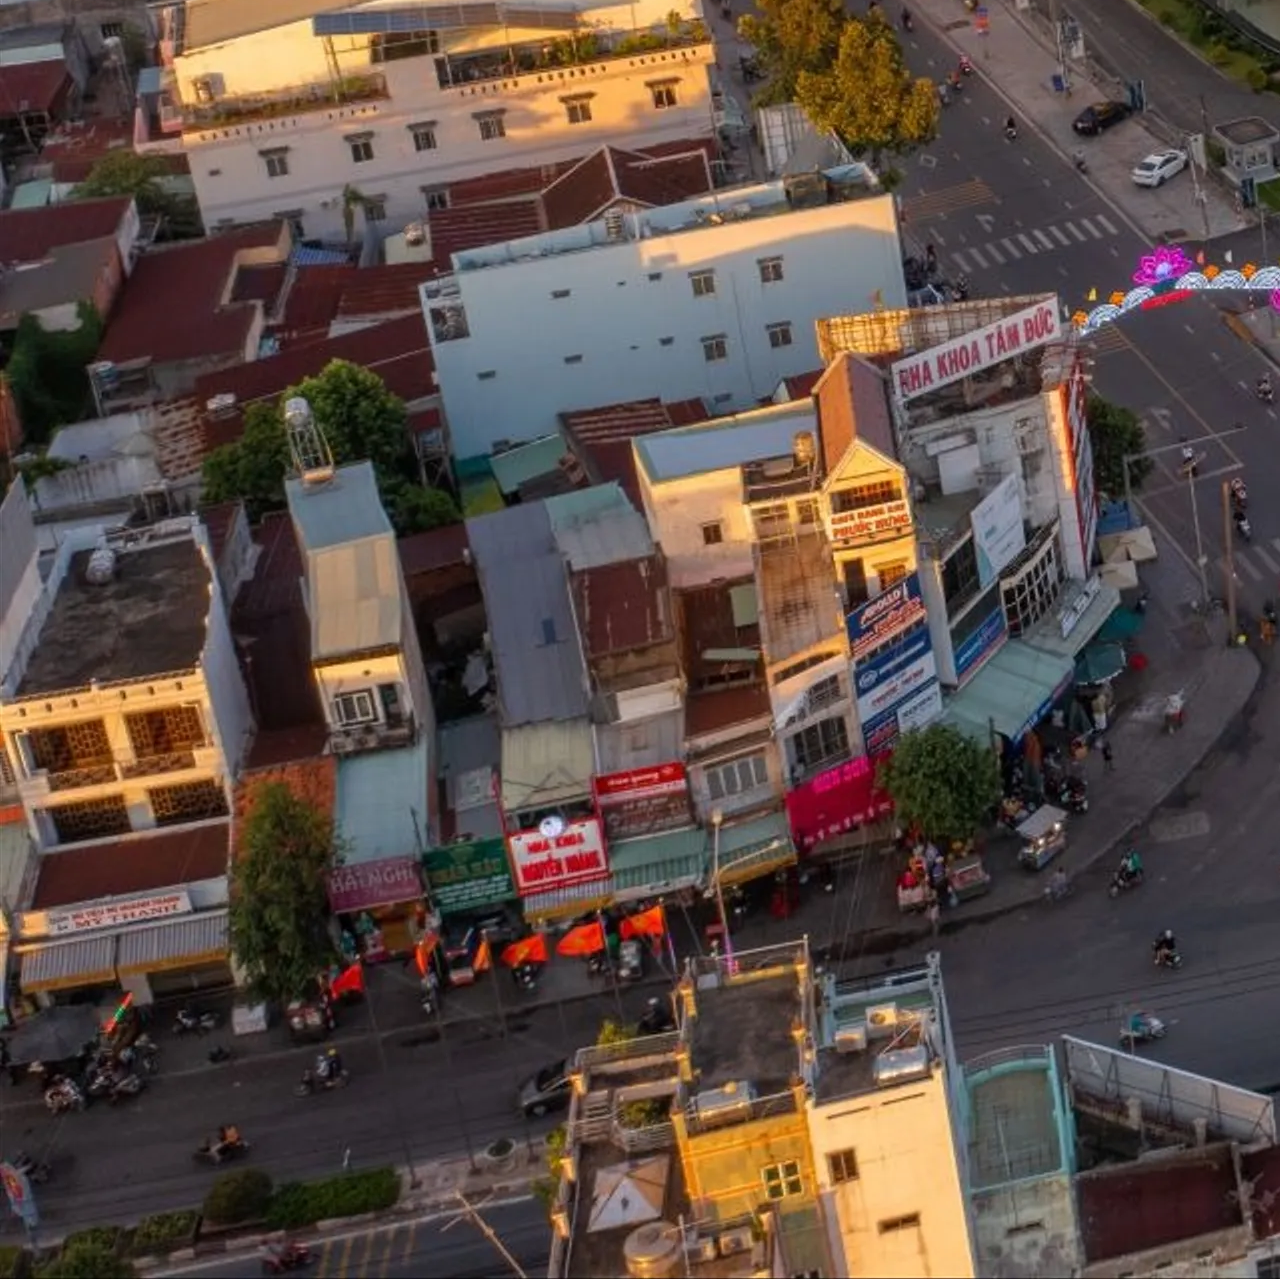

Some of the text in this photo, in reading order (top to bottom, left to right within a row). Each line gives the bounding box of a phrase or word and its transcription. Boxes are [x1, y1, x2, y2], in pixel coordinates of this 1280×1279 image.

[937, 339, 981, 380] KHOA
[985, 324, 1020, 360] TÂM
[1023, 307, 1055, 343] ĐỨC
